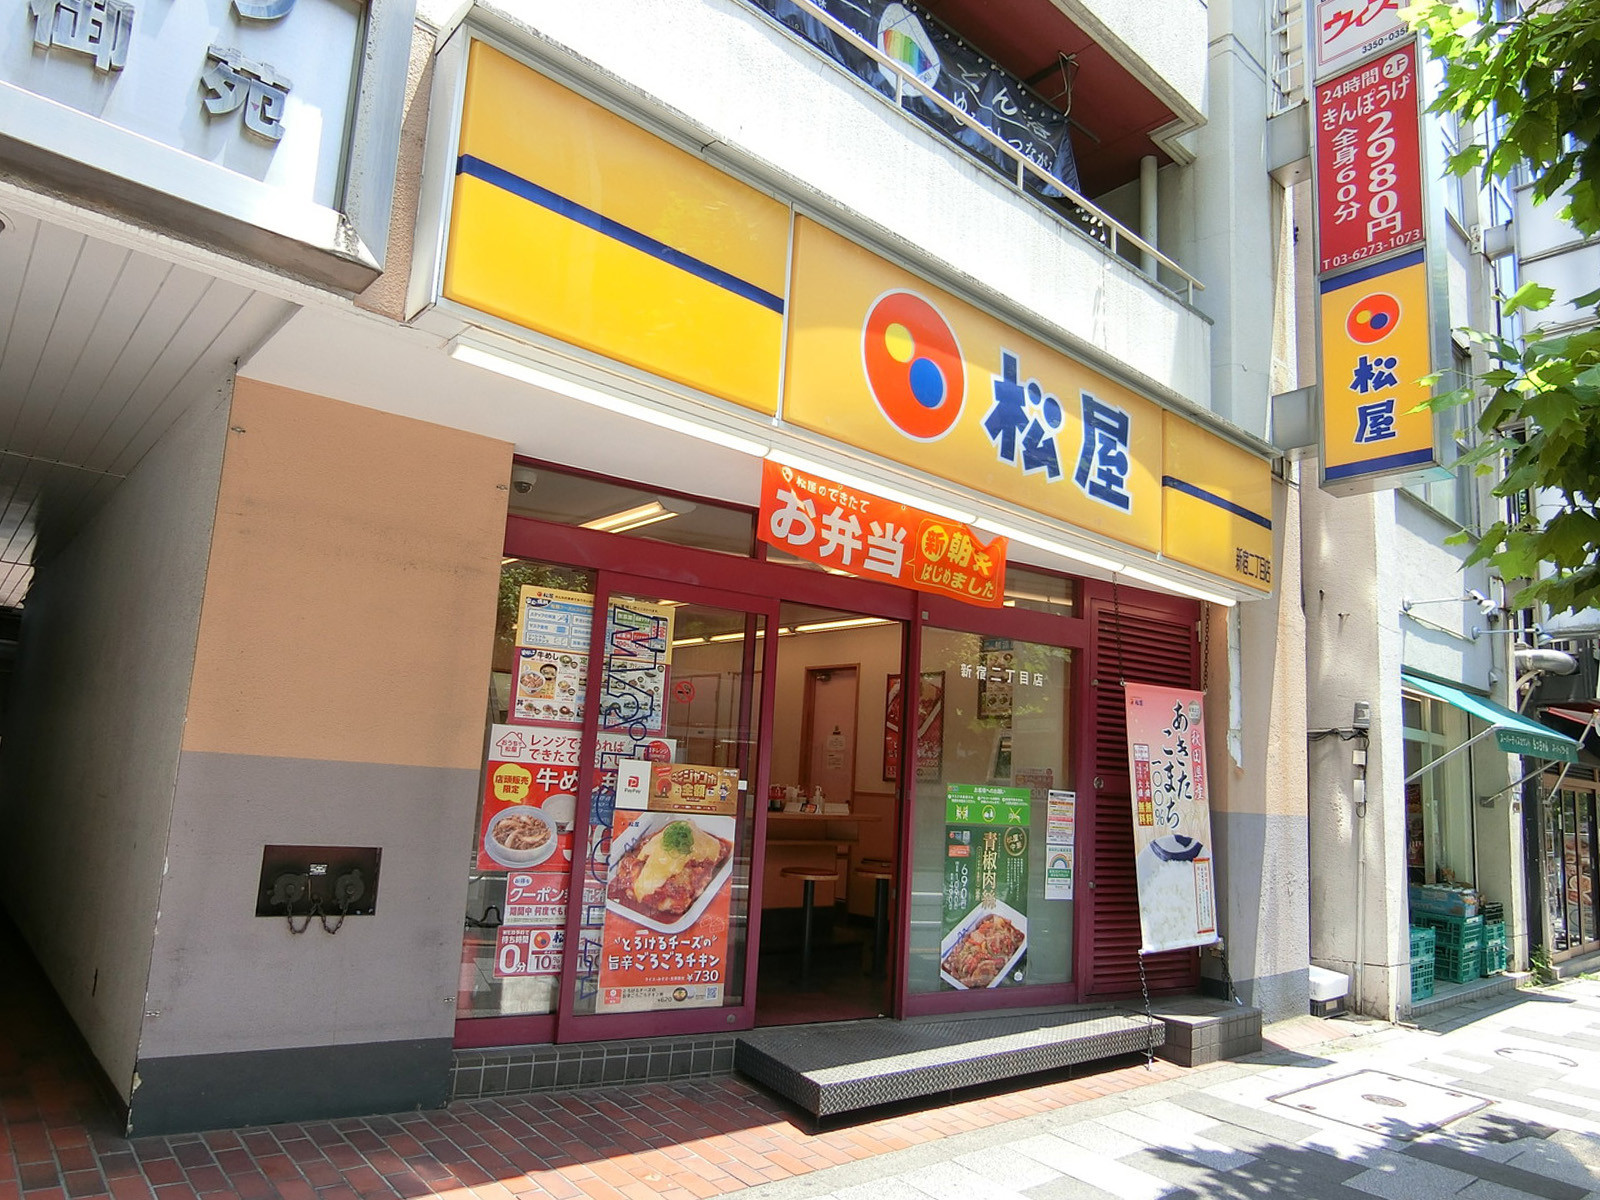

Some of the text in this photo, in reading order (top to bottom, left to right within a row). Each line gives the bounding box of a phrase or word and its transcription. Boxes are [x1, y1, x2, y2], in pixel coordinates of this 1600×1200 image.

[1322, 66, 1380, 106] 24時間
[1321, 74, 1412, 131] きんぽうげ
[1331, 128, 1362, 225] 全身60分
[1366, 110, 1402, 243] 2980円
[1322, 228, 1421, 270] T 03-6273-1073
[1349, 355, 1398, 444] 松屋
[981, 348, 1132, 513] 松屋
[796, 475, 870, 514] 松屋のできたて
[770, 488, 908, 579] お弁当
[921, 564, 994, 599] はじめました
[537, 651, 560, 661] 牛めし
[960, 663, 1045, 687] 新宿二丁目店
[495, 774, 529, 786] 店頭販売
[502, 784, 520, 794] 限定
[510, 906, 532, 916] 期間中
[501, 935, 529, 944] 待ち時間
[622, 935, 712, 951] とろけるチーズの
[500, 944, 528, 974] 0分
[608, 951, 720, 971] 旨辛ごろごろチキン
[686, 970, 719, 982] ¥730
